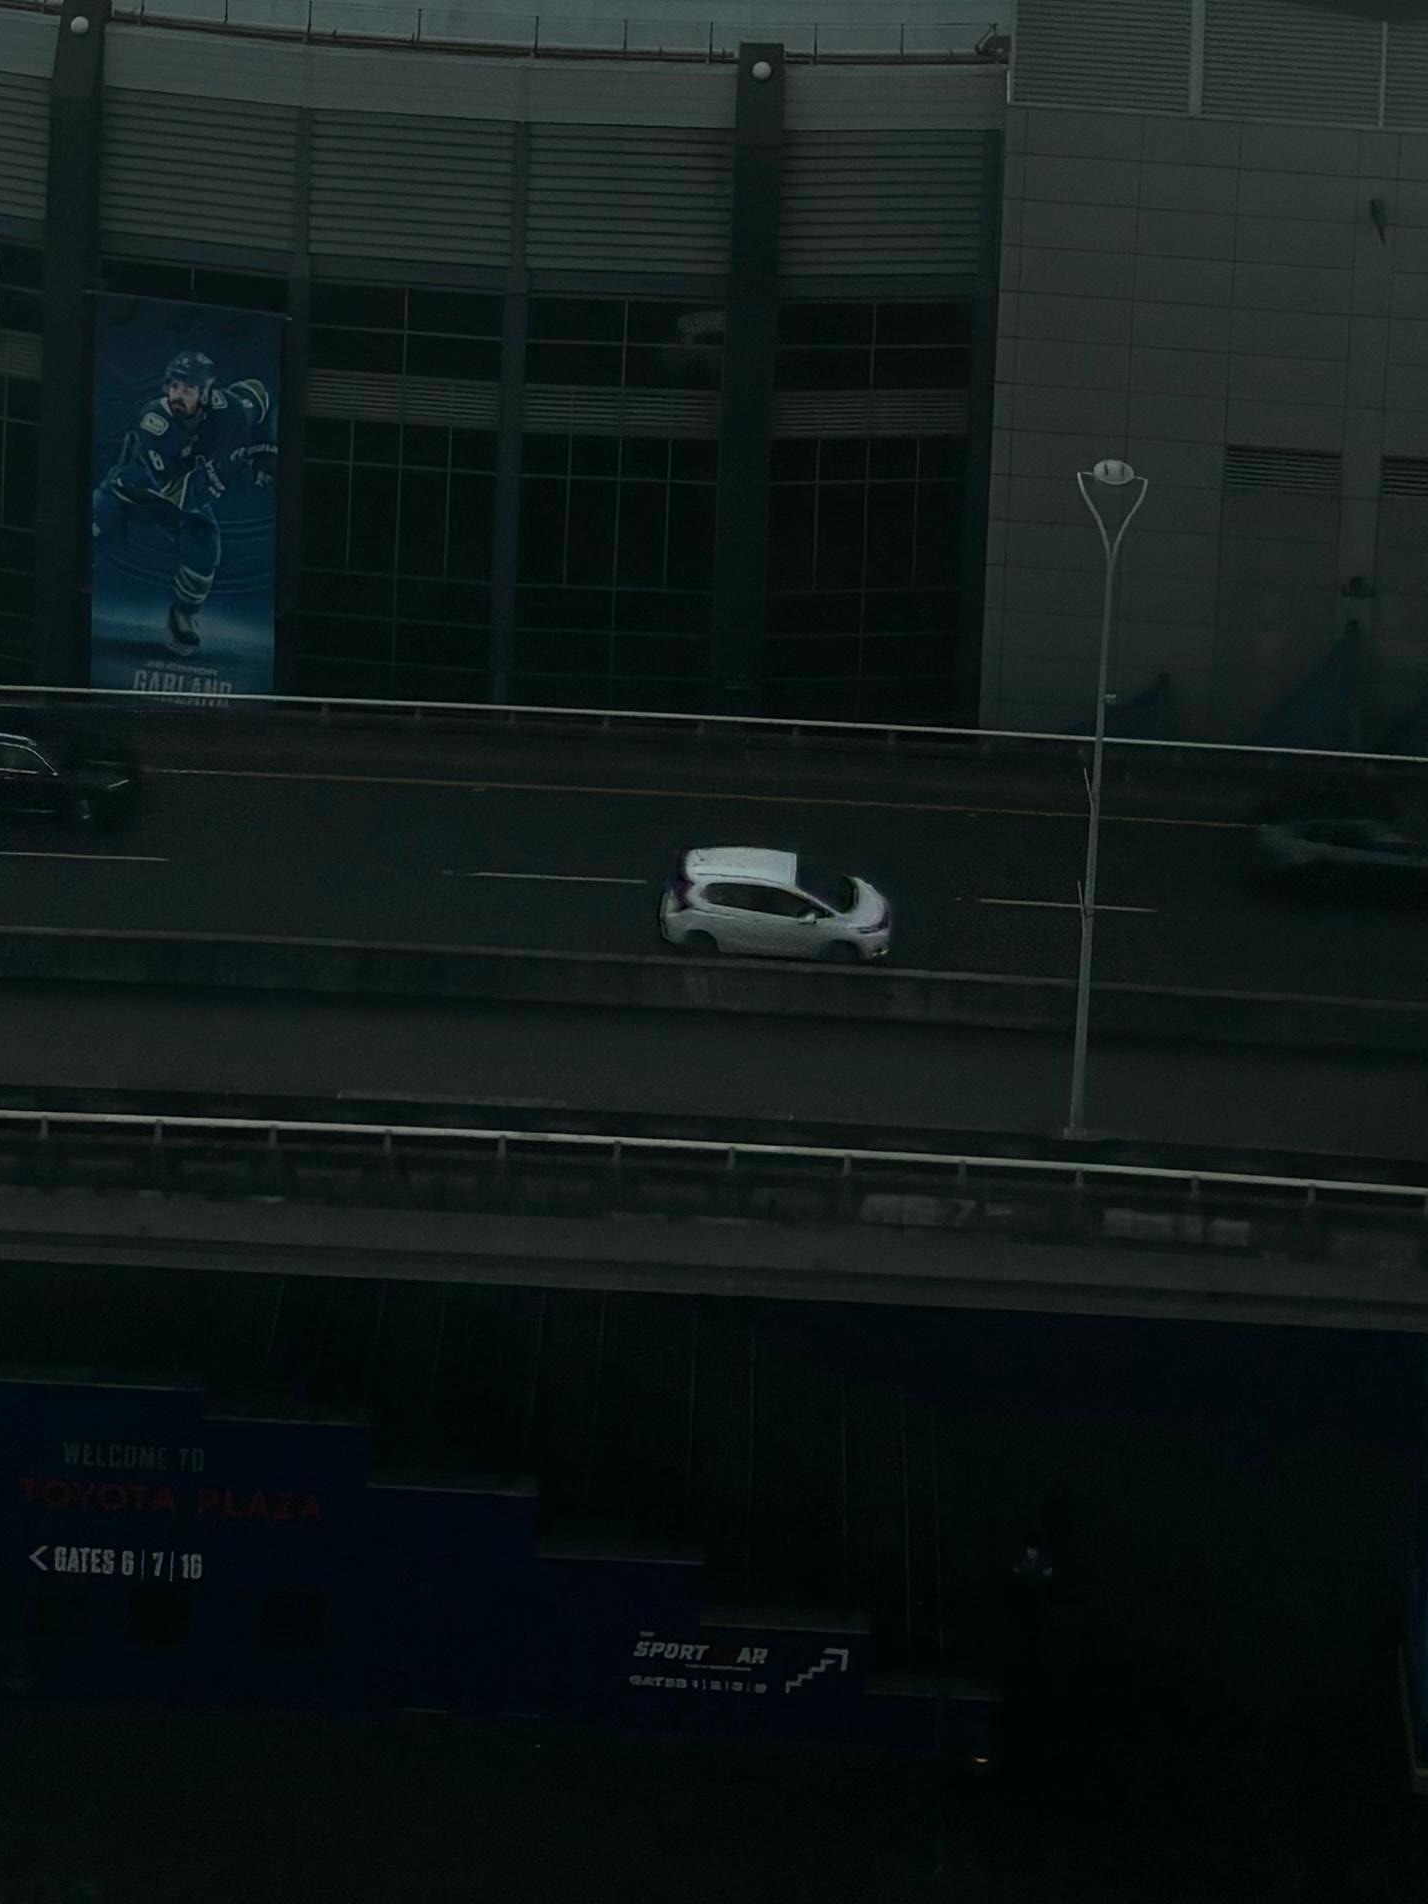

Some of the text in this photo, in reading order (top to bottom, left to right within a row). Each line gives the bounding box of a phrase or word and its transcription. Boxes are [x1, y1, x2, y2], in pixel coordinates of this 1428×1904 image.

[61, 1440, 205, 1473] WELCOME TO
[18, 1476, 324, 1521] TOYOTA PLAZA
[53, 1545, 116, 1576] GATES
[151, 1550, 165, 1578] 7
